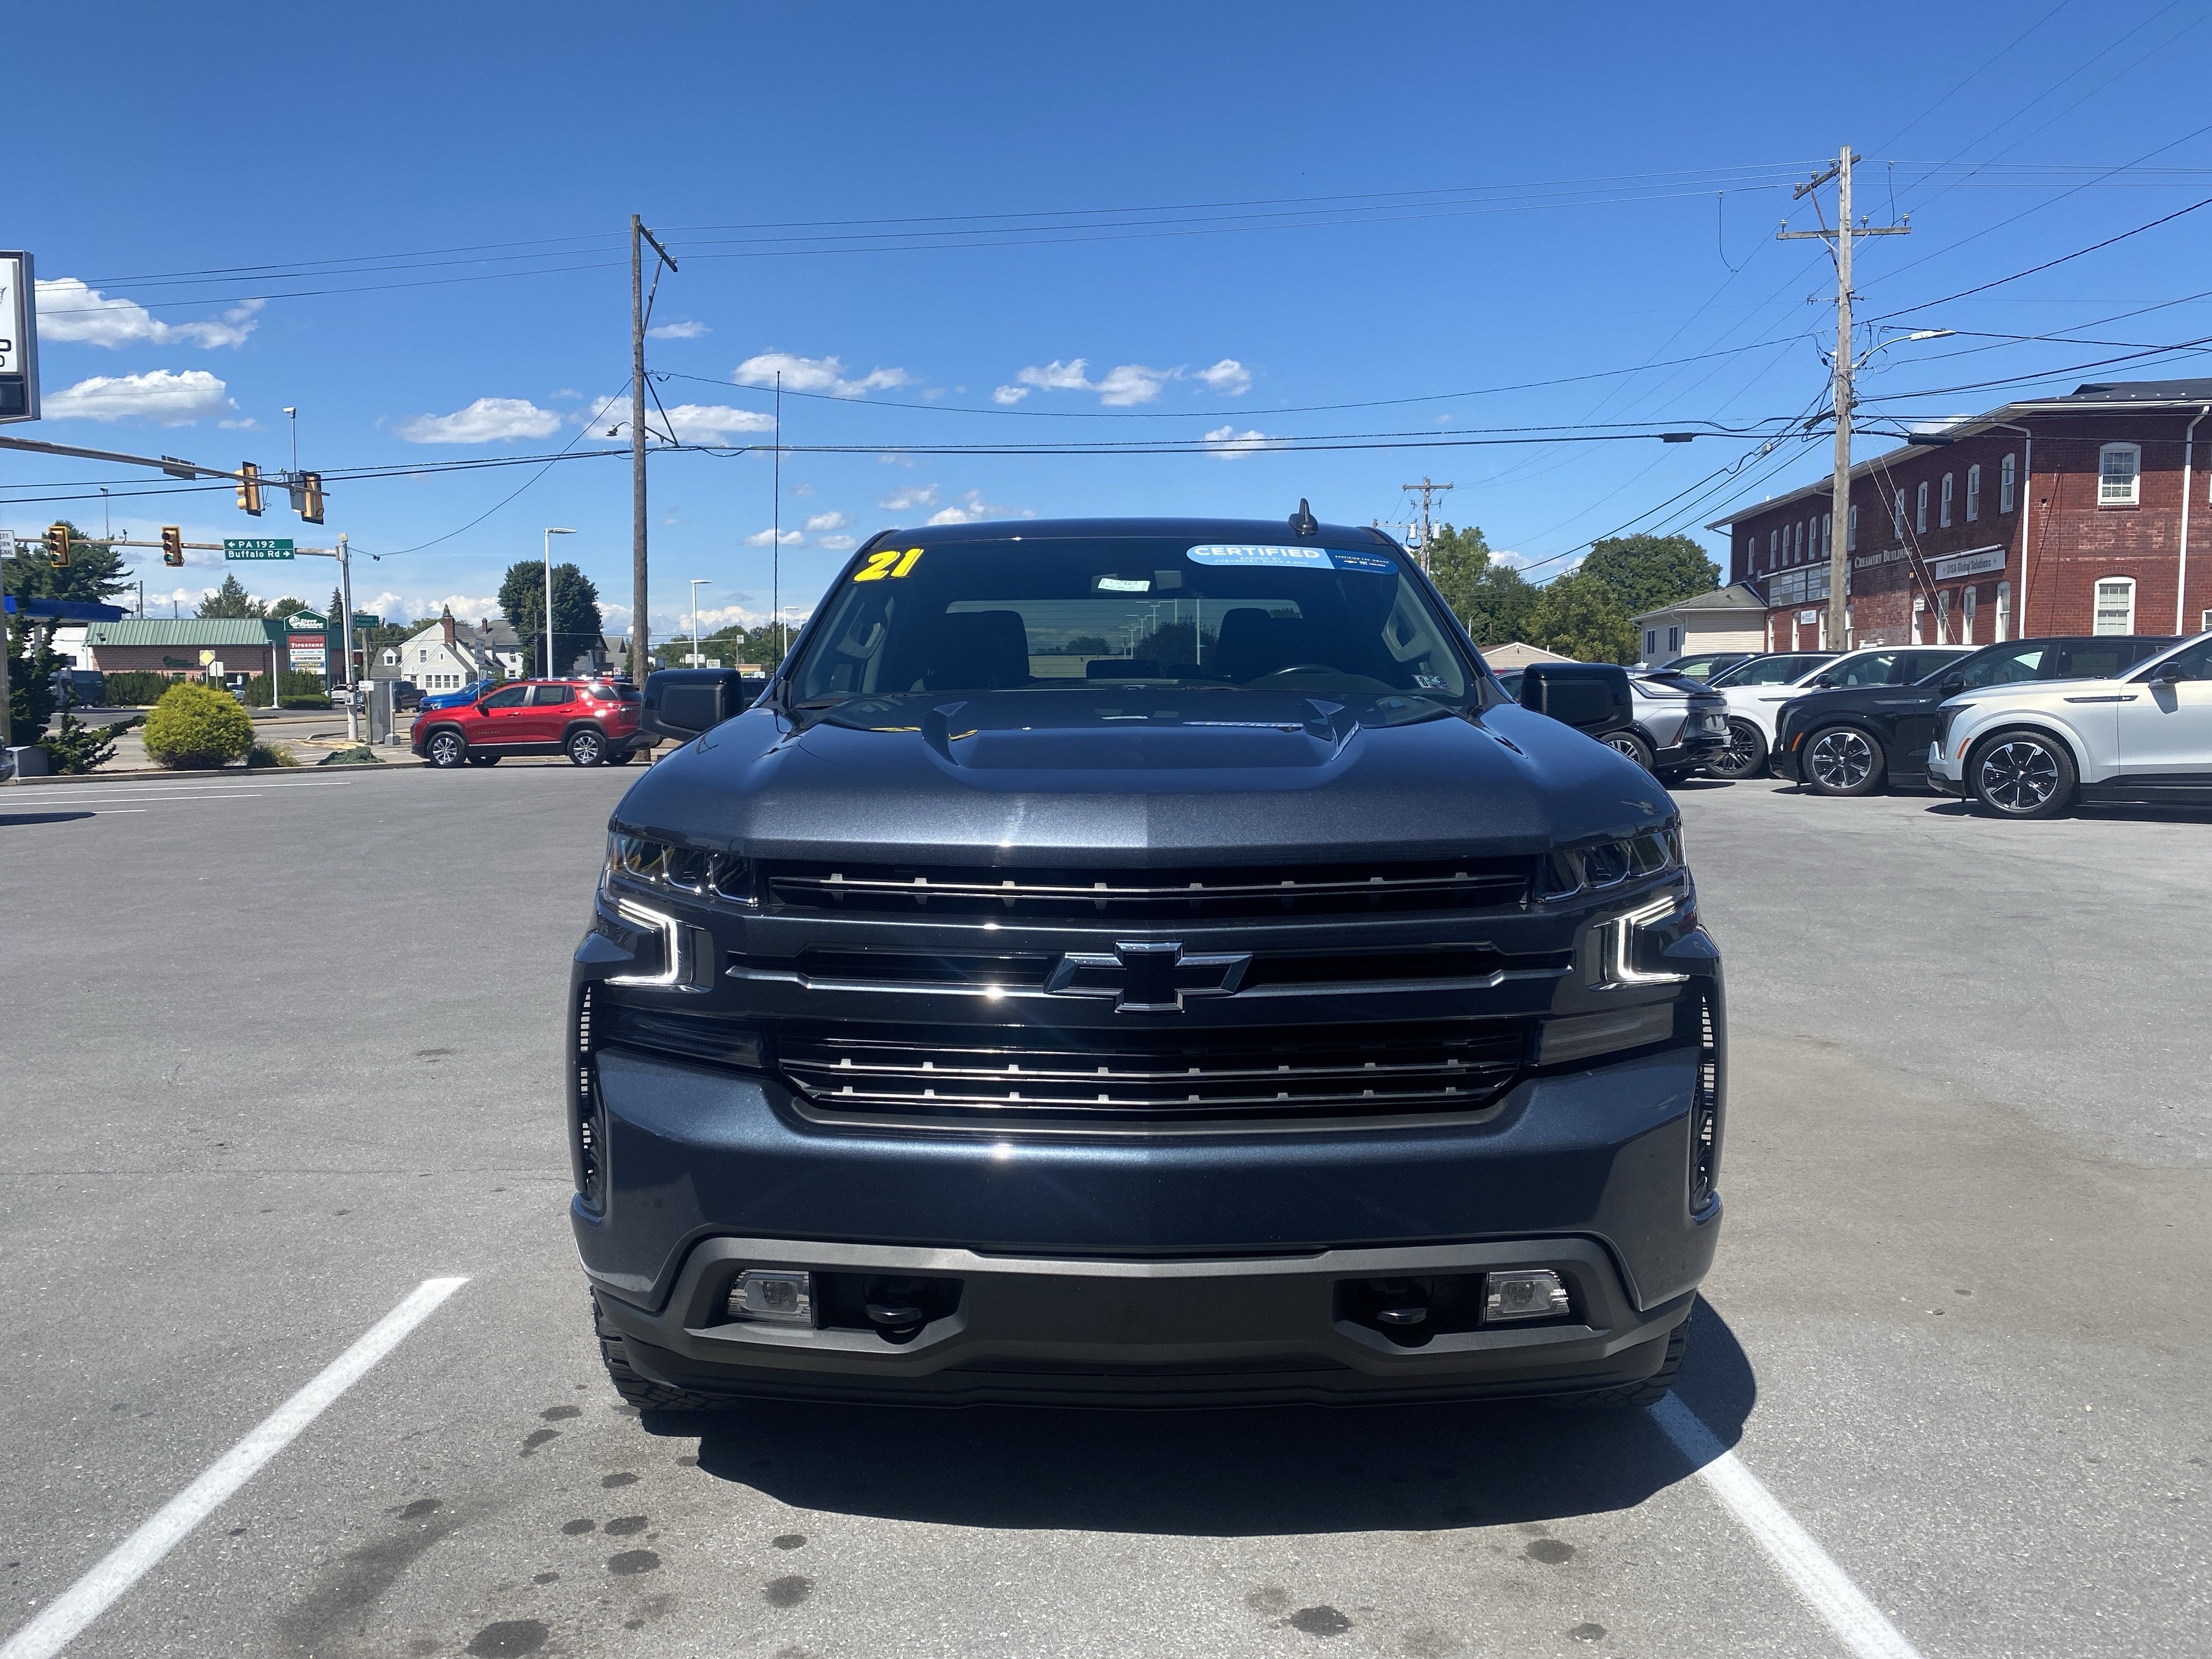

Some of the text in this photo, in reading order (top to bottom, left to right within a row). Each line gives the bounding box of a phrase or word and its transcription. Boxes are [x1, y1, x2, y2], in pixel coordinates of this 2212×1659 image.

[1194, 547, 1321, 558] CERTIFIED
[1854, 546, 1912, 569] CREAMERY BUILDING
[854, 548, 924, 582] 21
[1947, 558, 1991, 574] DISA Global Solutions
[1419, 676, 1429, 687] 8
